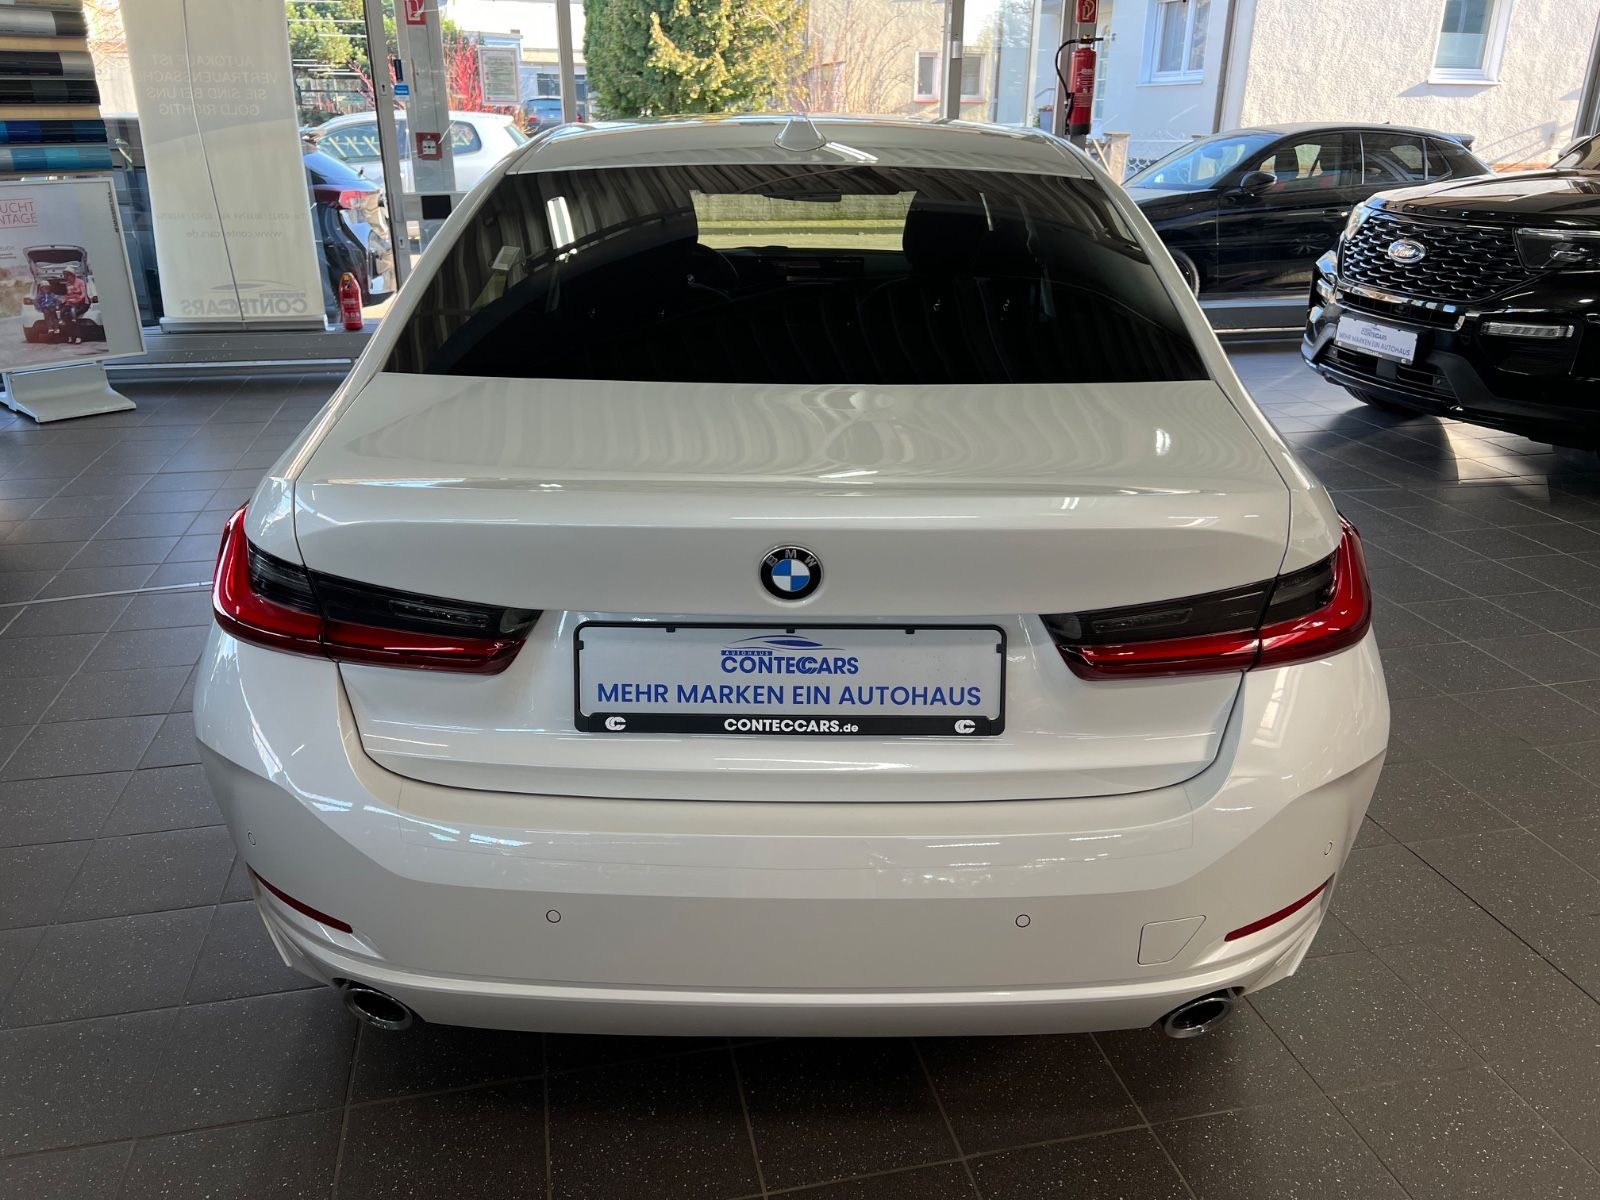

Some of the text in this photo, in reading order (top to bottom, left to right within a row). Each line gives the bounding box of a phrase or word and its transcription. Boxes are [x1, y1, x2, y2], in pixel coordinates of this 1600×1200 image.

[1381, 343, 1411, 356] AUTOHAUS
[765, 549, 817, 568] BMW
[597, 683, 982, 706] MEHR MARKEN EIN AUTOHAUS
[723, 718, 859, 733] CONTECCARS.de
